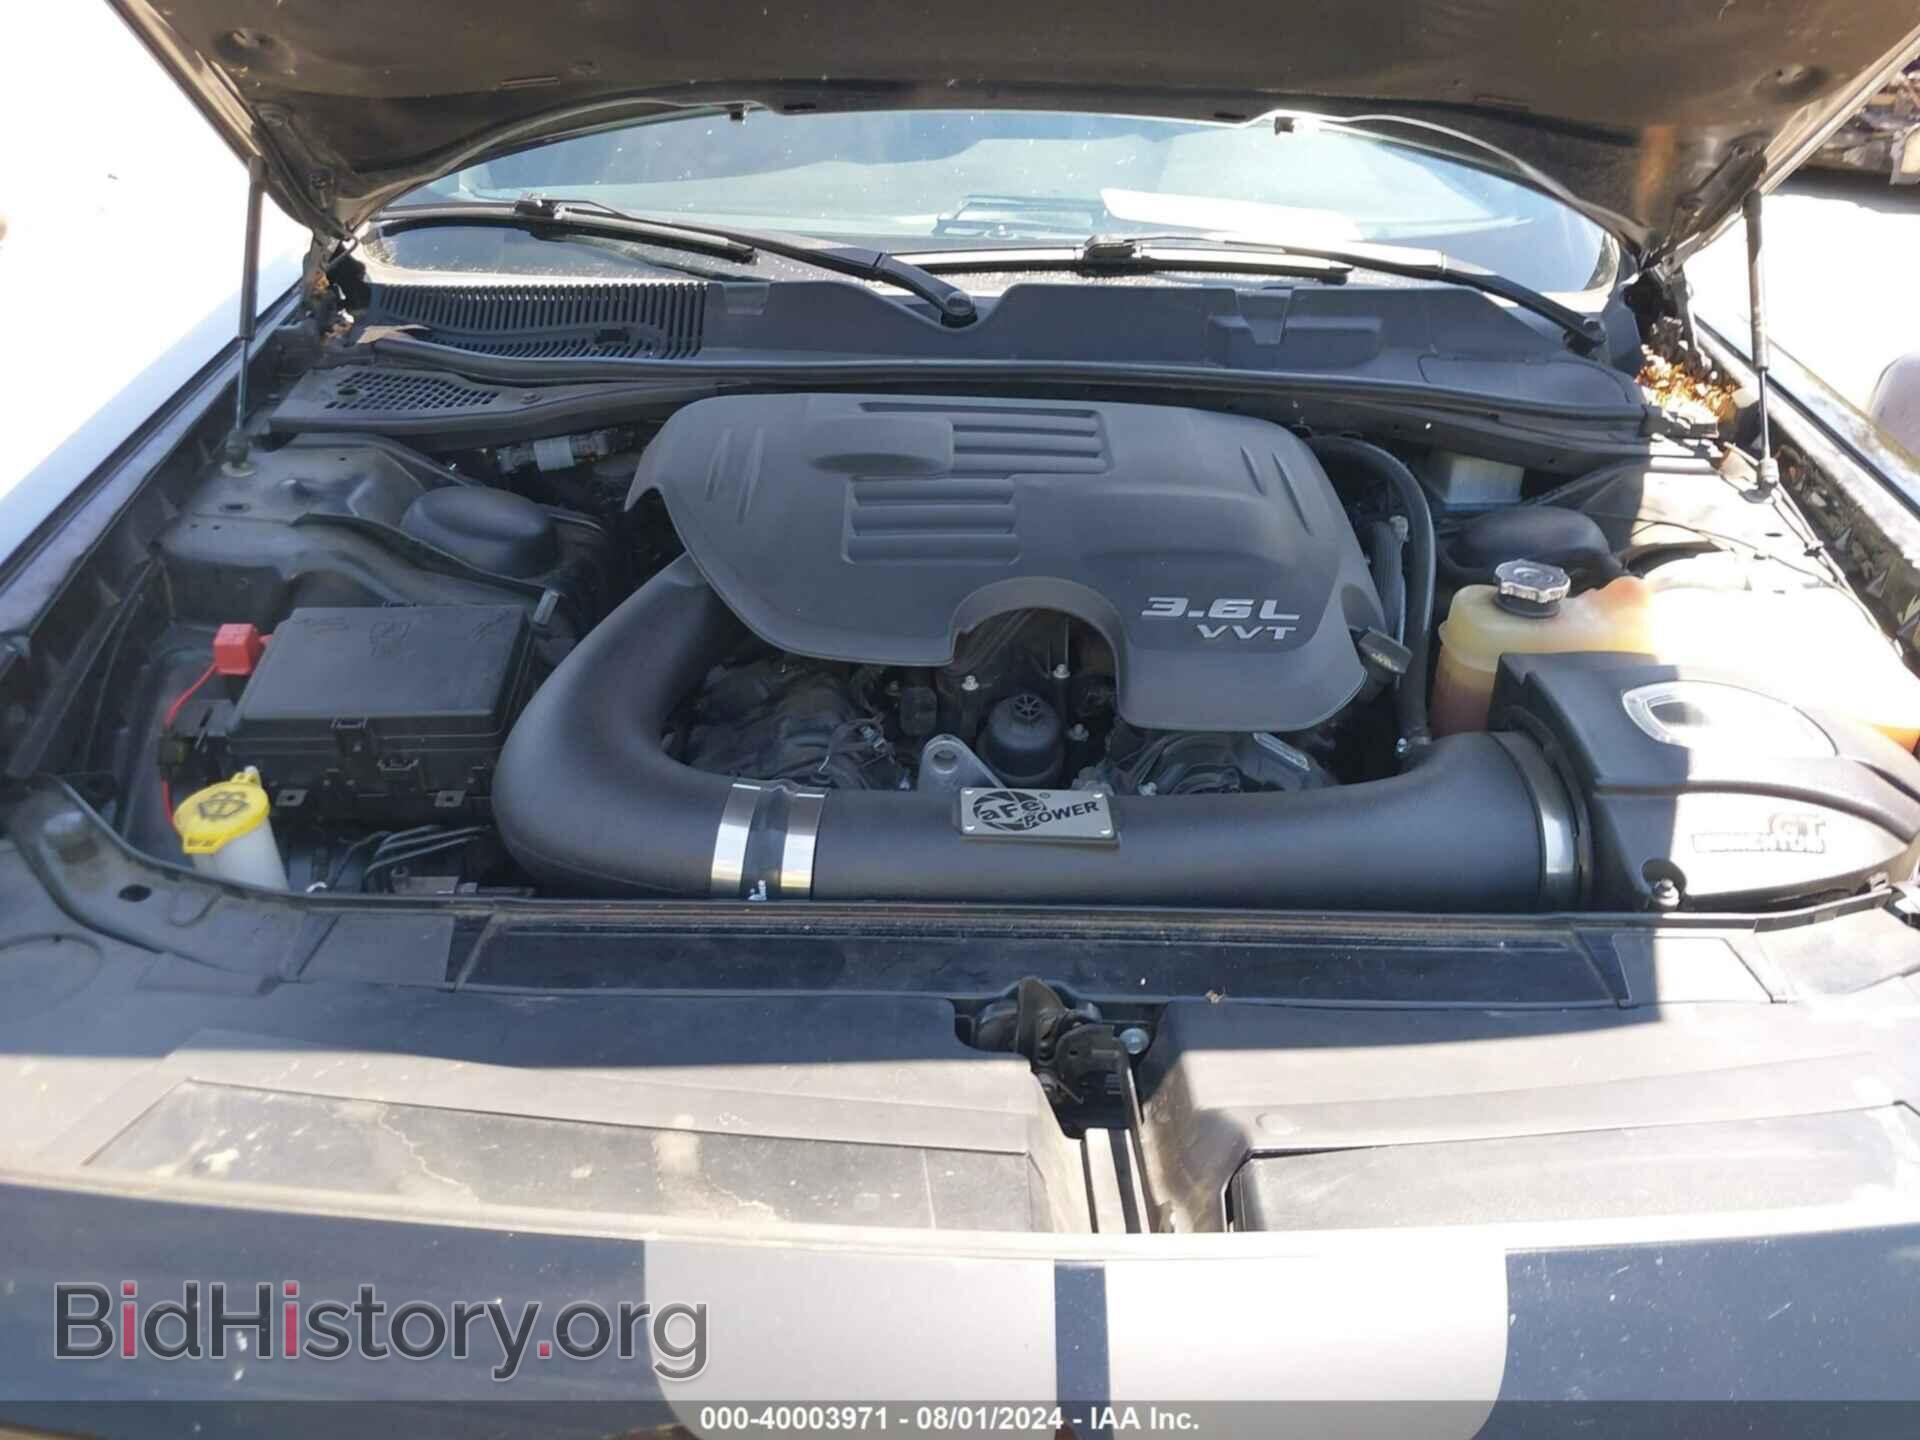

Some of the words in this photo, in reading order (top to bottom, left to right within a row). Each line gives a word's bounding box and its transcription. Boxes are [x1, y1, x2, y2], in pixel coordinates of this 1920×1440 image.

[1141, 597, 1300, 620] 3.6L
[1197, 624, 1297, 640] VVT
[979, 799, 1041, 821] aFe
[1024, 801, 1099, 827] POWER
